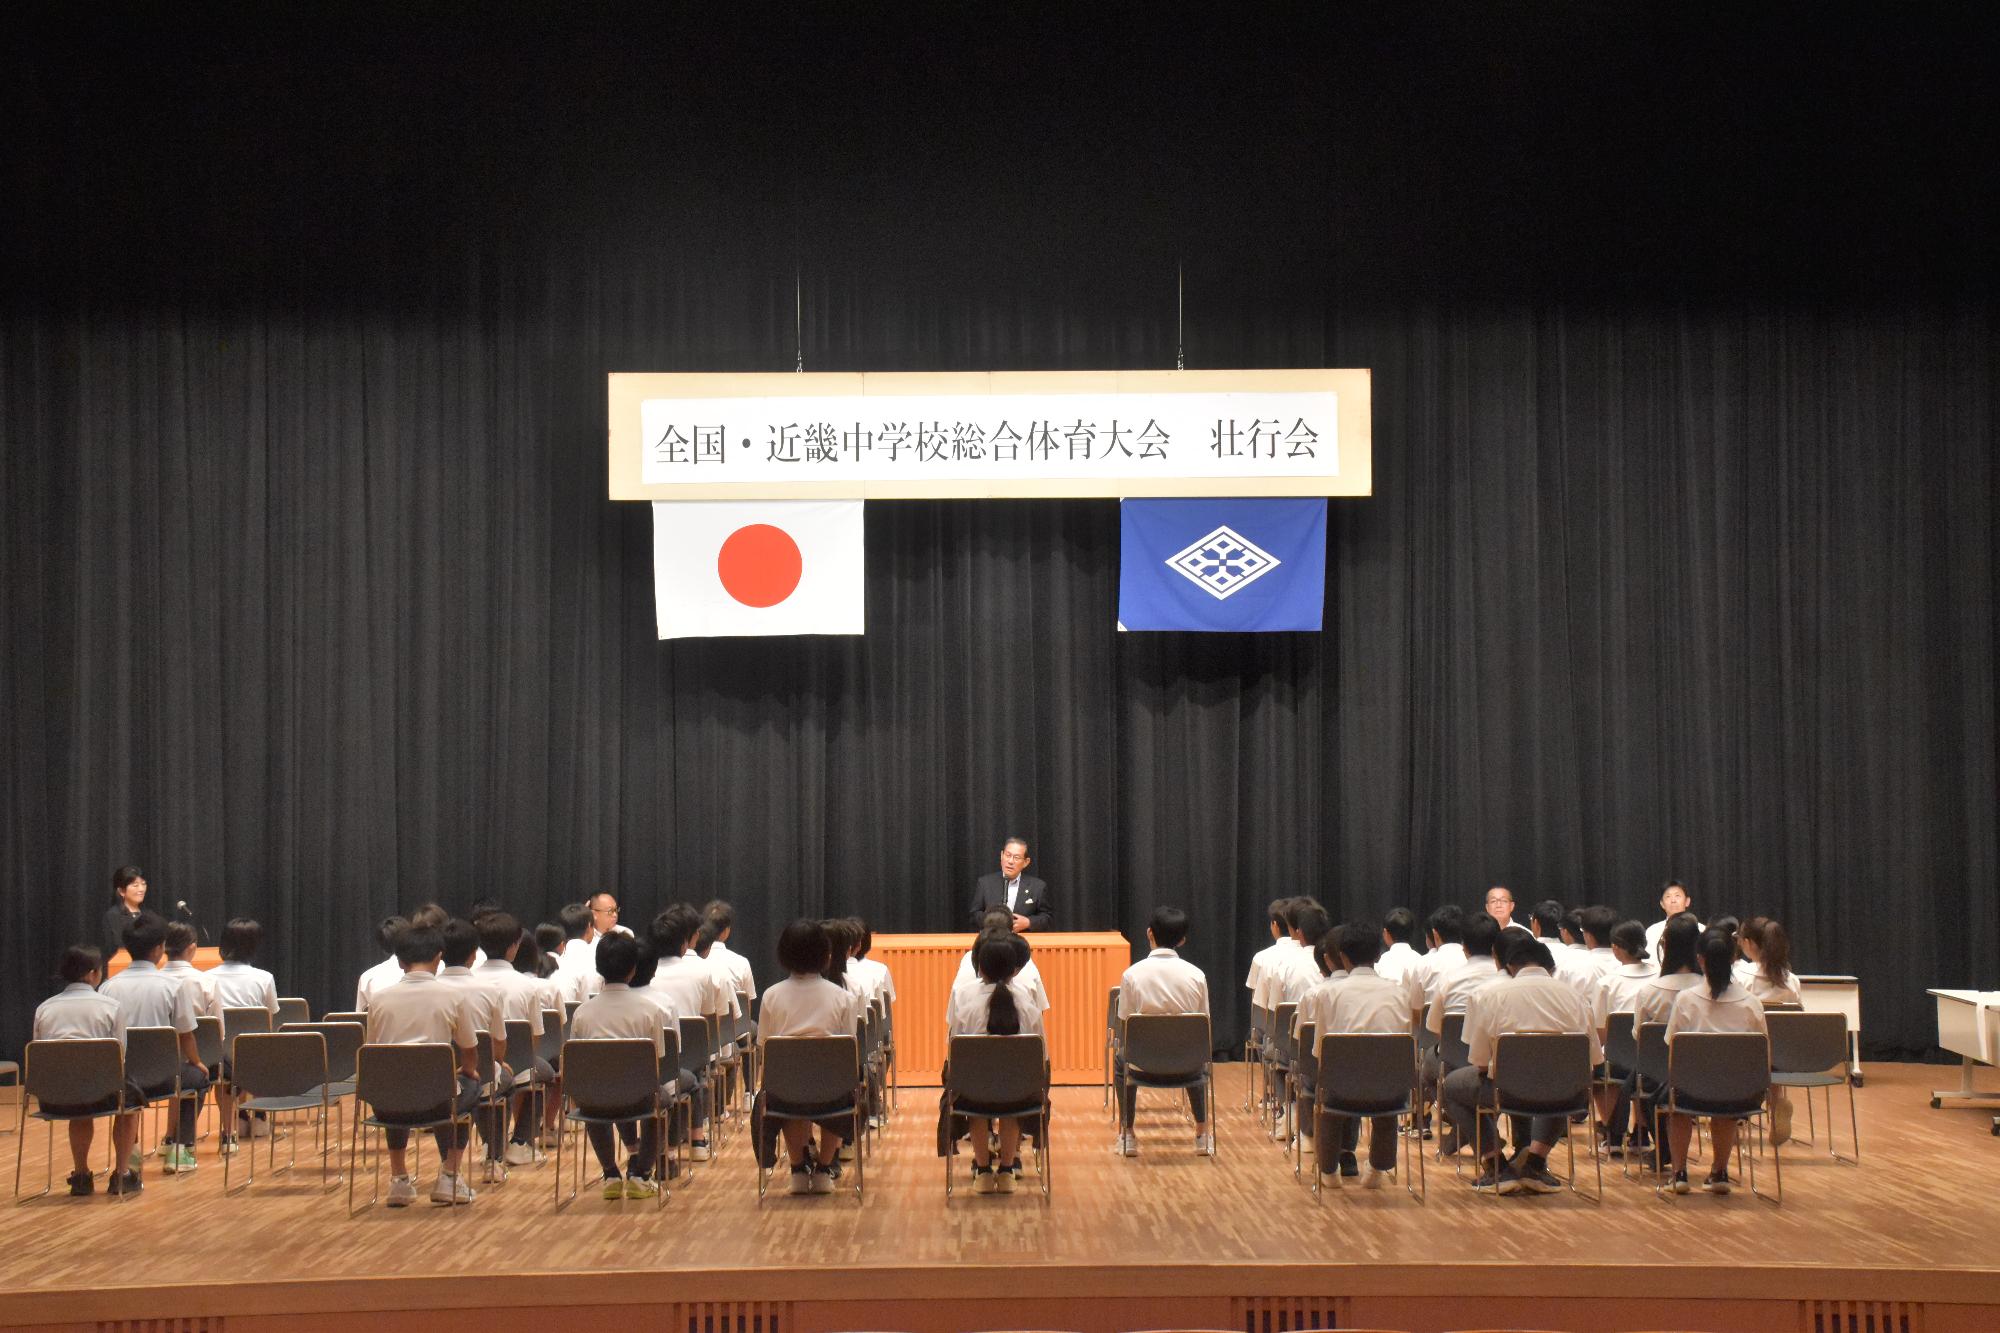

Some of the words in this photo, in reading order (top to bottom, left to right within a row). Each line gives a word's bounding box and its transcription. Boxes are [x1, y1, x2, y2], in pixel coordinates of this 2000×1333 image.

[655, 418, 1171, 464] 全国・近畿中学校総合体育大会
[1210, 417, 1319, 459] 壮行会
